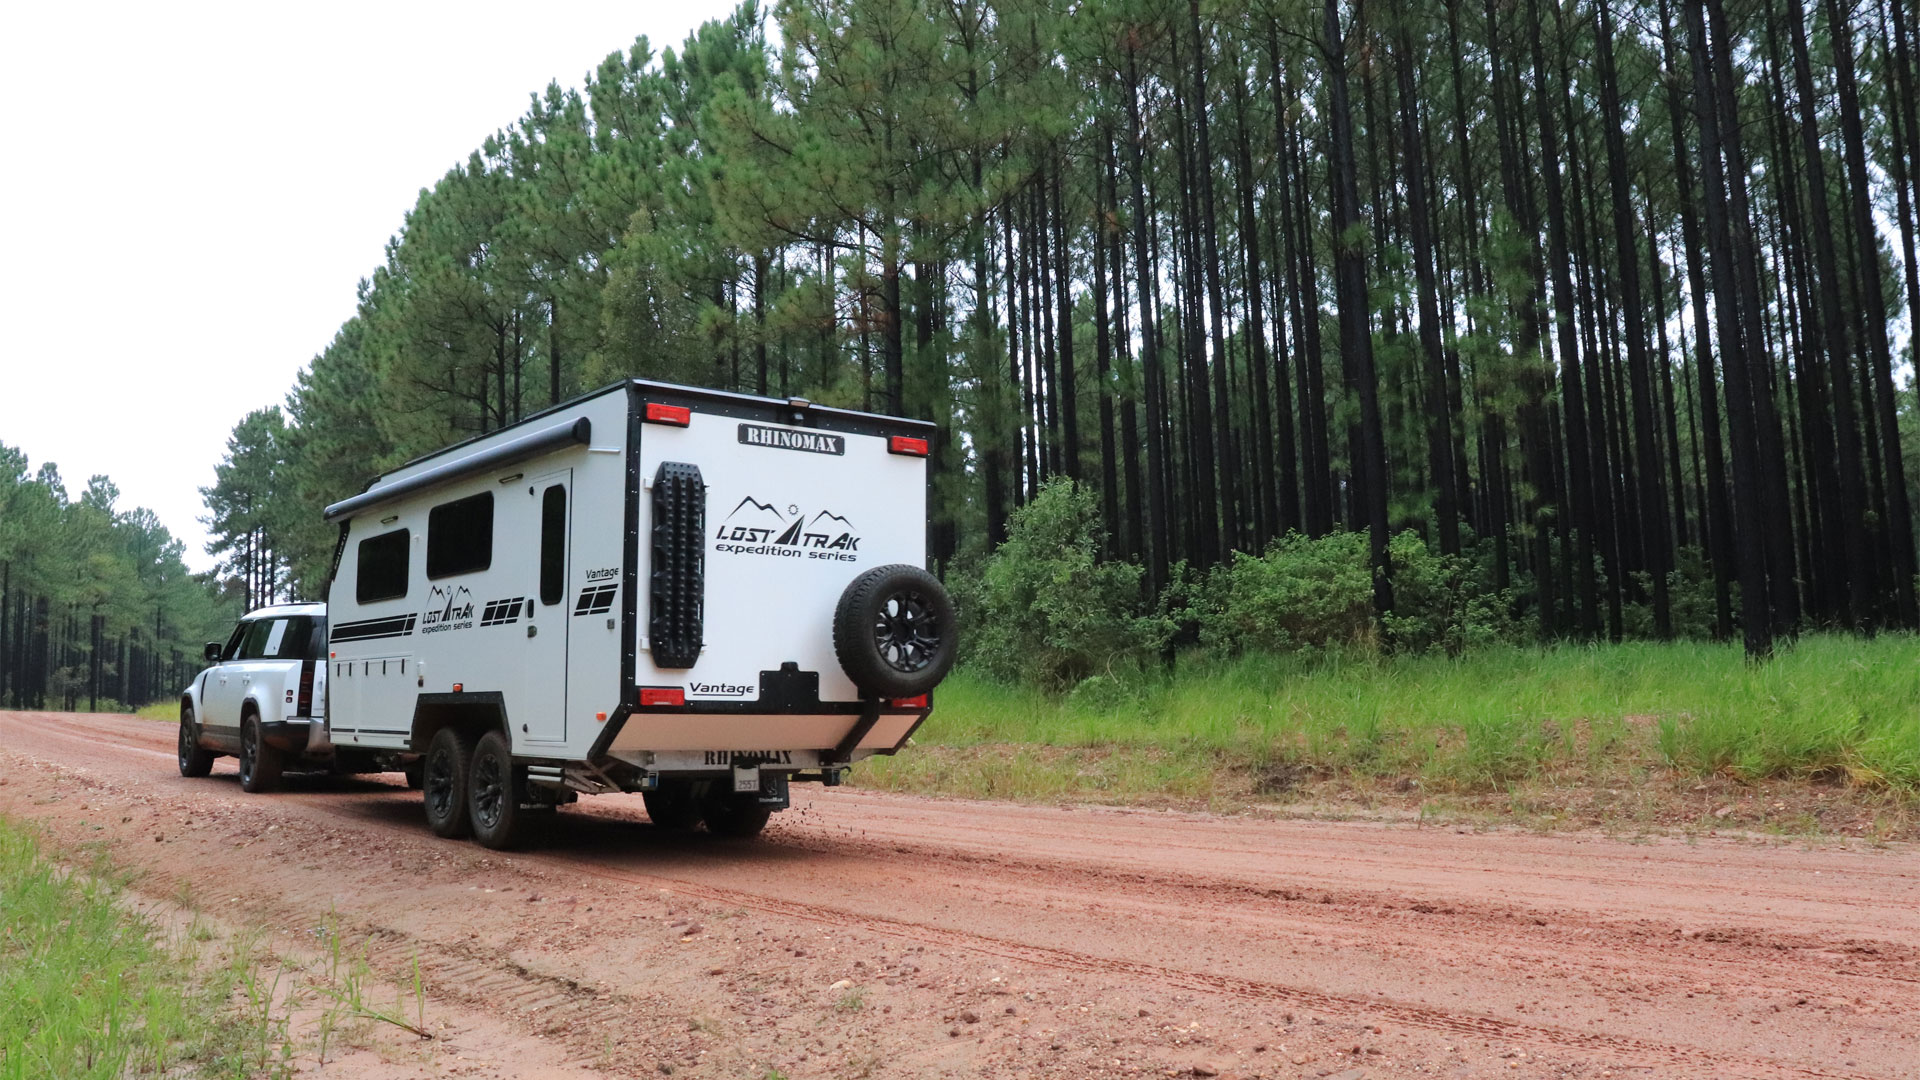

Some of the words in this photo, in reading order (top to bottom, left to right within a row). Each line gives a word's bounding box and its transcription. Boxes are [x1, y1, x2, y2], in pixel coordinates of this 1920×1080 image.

[747, 427, 837, 453] RHINOMAX
[716, 525, 776, 543] LOST
[803, 532, 862, 551] TRAK
[715, 543, 802, 558] expedition
[808, 551, 857, 562] series
[586, 568, 619, 582] Vantage
[422, 610, 442, 624] LOST
[422, 623, 451, 635] expedition
[453, 620, 473, 630] series
[690, 682, 754, 696] Vantage
